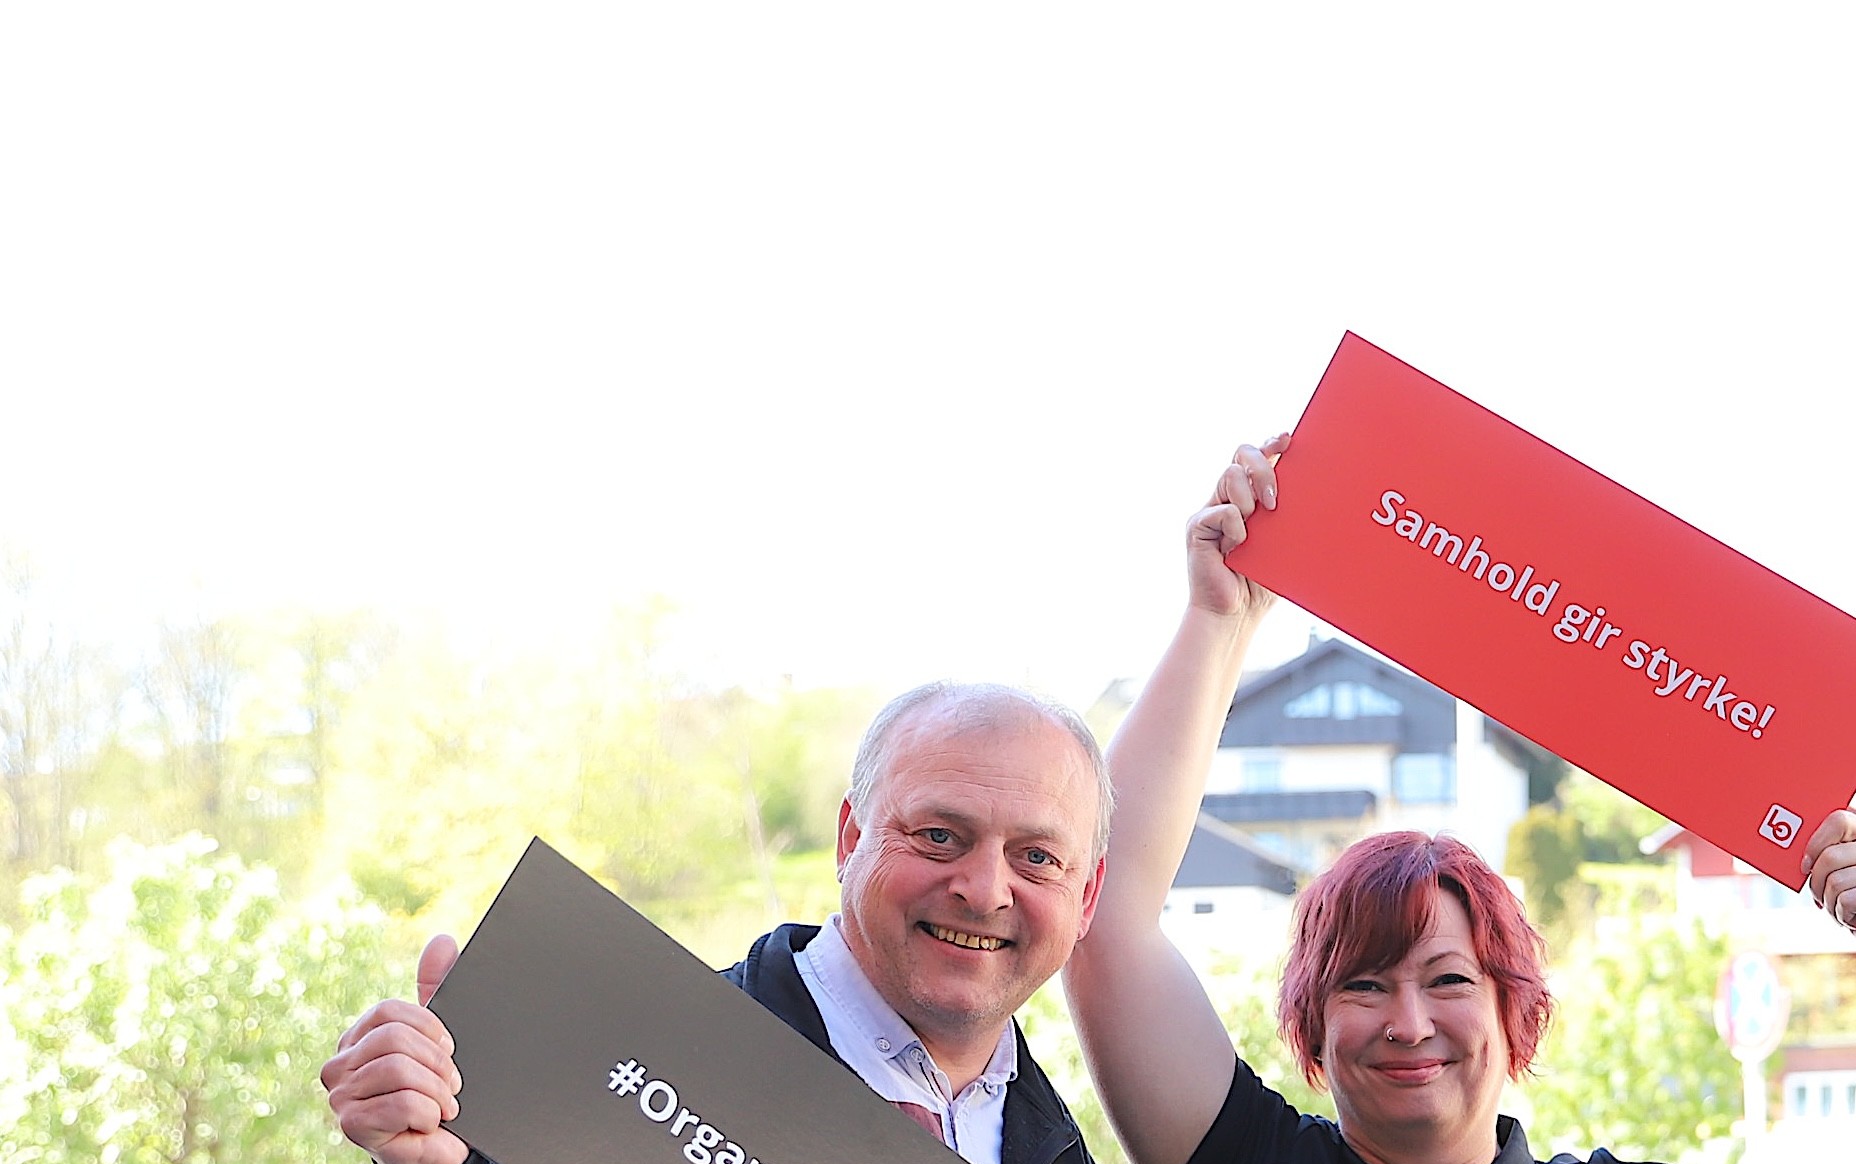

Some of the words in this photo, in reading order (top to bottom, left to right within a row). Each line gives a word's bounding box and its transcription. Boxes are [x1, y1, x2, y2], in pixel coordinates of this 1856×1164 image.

[1371, 490, 1562, 617] Samhold
[1552, 601, 1622, 648] gir
[1622, 636, 1776, 740] styrke!
